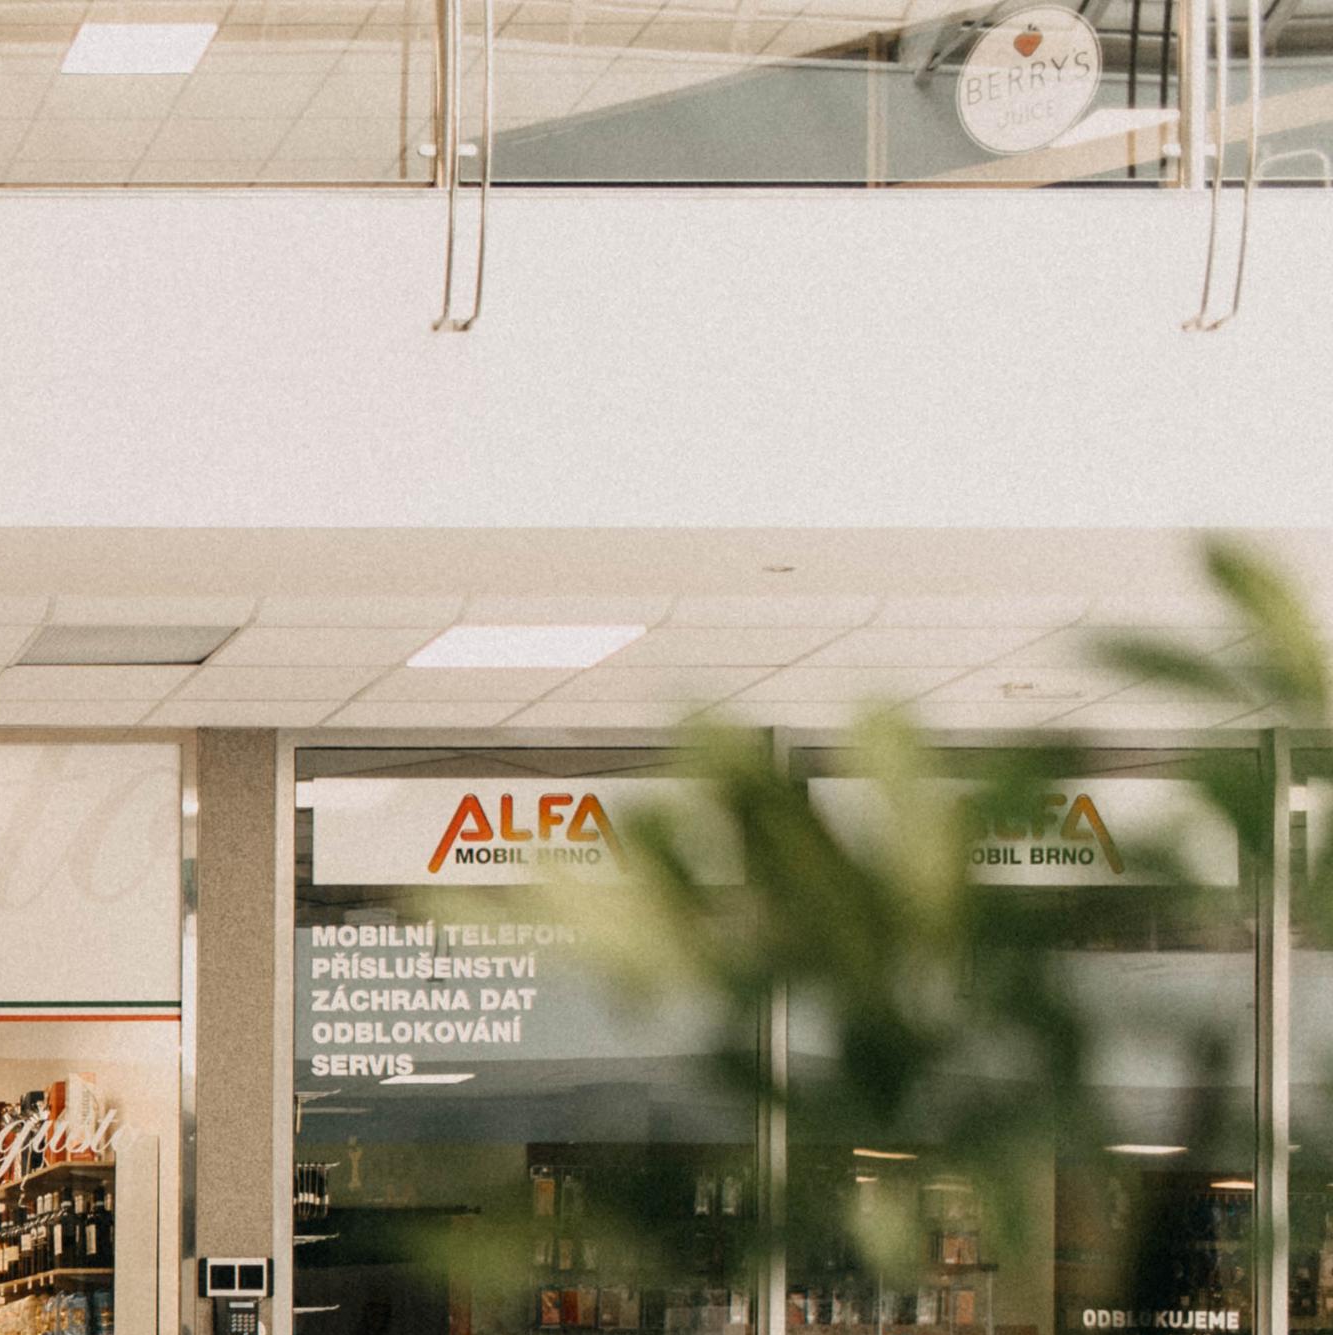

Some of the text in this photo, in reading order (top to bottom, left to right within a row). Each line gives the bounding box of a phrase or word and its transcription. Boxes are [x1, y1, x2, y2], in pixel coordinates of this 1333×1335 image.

[966, 49, 1091, 106] BERRY'S
[428, 793, 631, 873] ALFA
[455, 848, 528, 864] MOBIL
[971, 847, 1095, 865] OBIL BRNO
[311, 920, 433, 947] MOBILNÍ
[311, 952, 536, 979] PŘÍSLUŠENSTVÍ
[311, 984, 537, 1012] ZÁCHRANA DAT
[311, 1016, 522, 1043] ODBLOKOVÁNÍ
[311, 1054, 414, 1076] SERVIS
